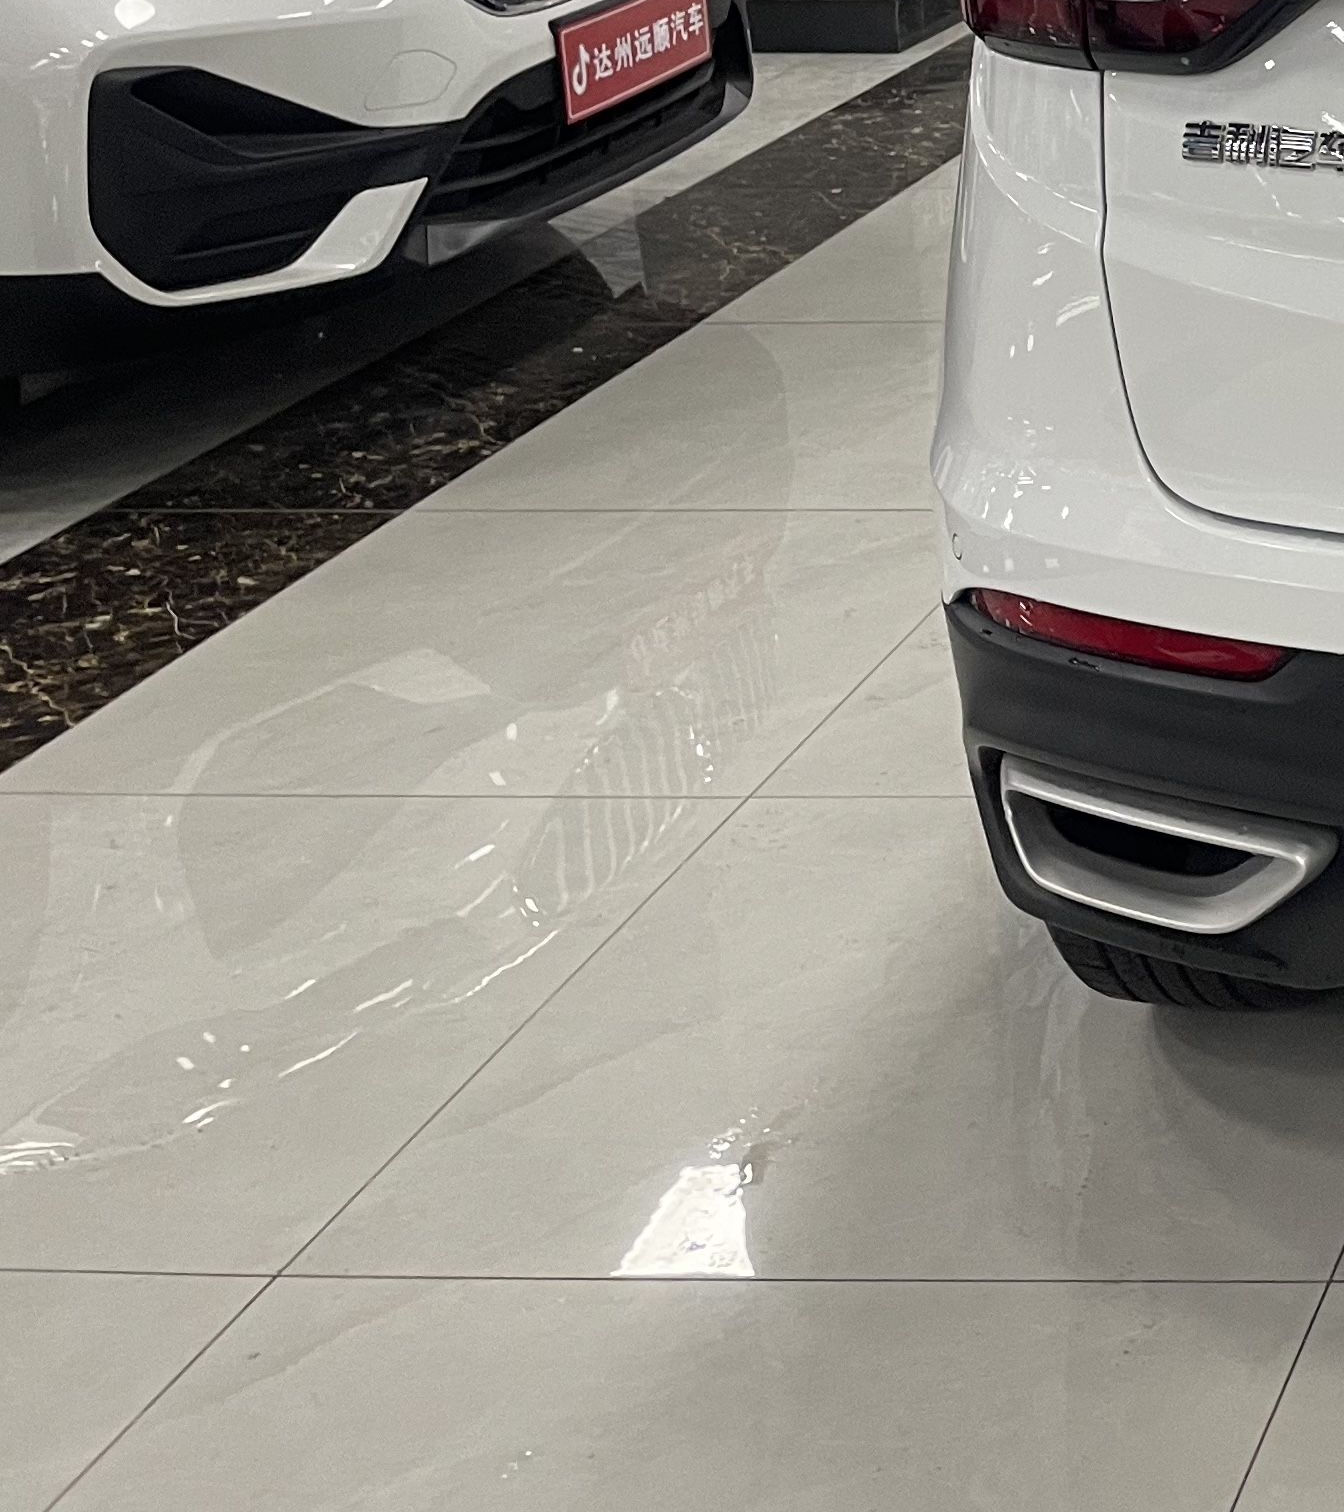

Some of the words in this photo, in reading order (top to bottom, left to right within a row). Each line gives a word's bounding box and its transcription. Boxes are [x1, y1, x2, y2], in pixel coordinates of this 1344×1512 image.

[593, 2, 705, 82] 达州远顺汽车
